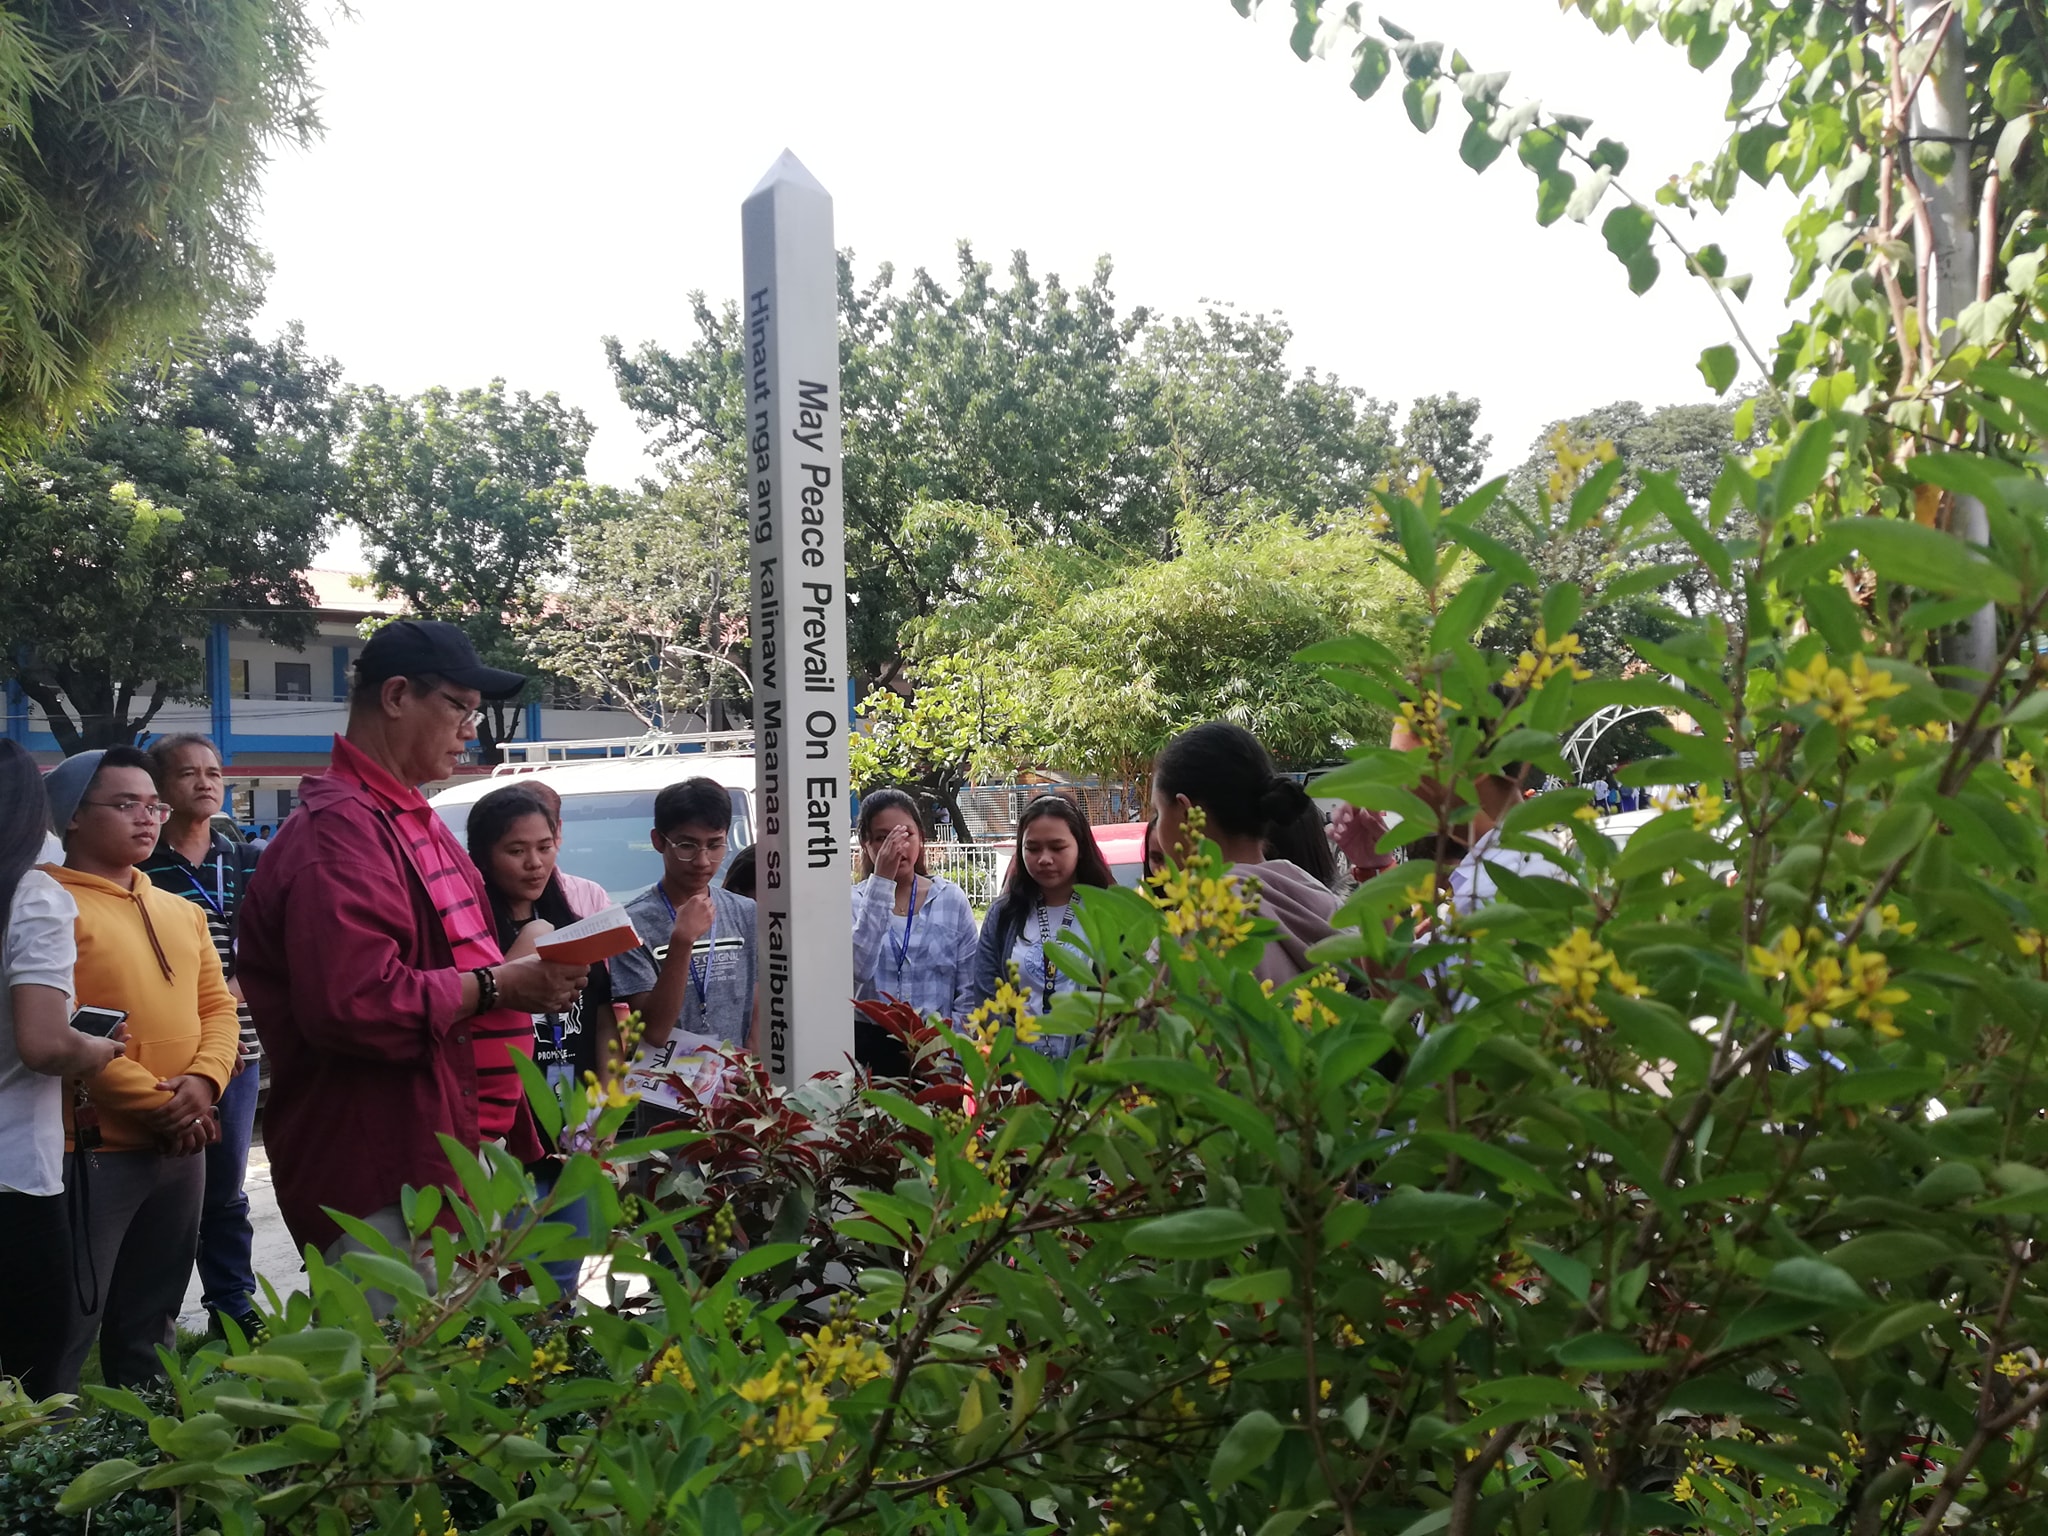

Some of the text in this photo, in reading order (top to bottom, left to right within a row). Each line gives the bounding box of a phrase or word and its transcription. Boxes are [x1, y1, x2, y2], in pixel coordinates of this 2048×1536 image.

[751, 287, 787, 1075] Hinaut nga ang kalinaw Maanaa sa kalibutan
[792, 379, 838, 869] May Peace Prevail On Earth
